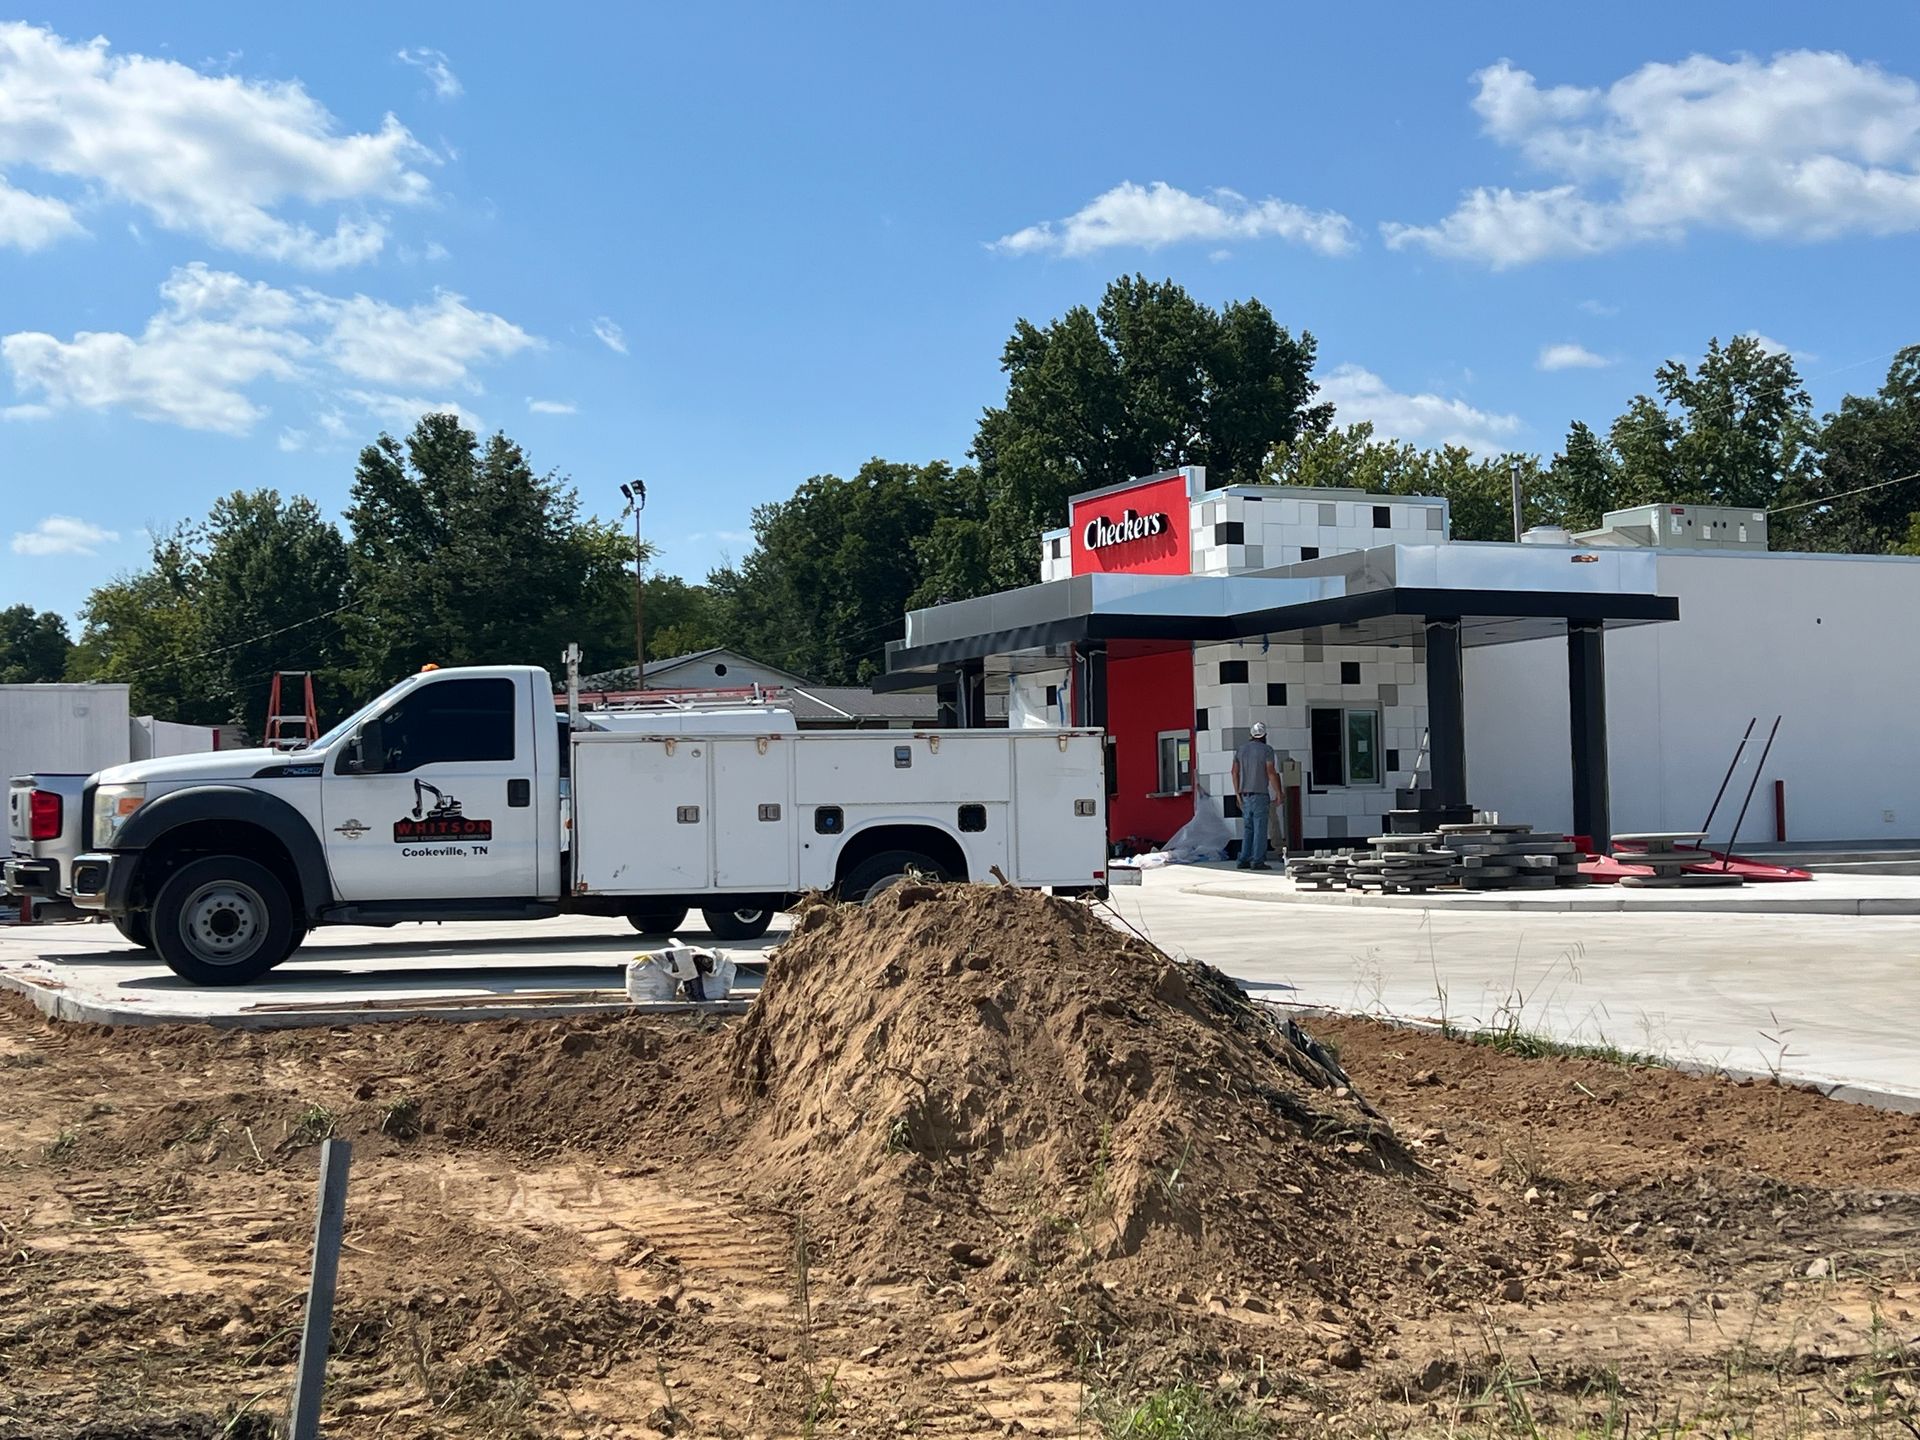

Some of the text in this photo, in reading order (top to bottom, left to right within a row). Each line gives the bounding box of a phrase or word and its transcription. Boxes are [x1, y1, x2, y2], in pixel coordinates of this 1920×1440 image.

[1084, 509, 1162, 551] Checkers
[397, 821, 490, 834] WHITSON
[402, 846, 488, 857] Cookeville, TN
